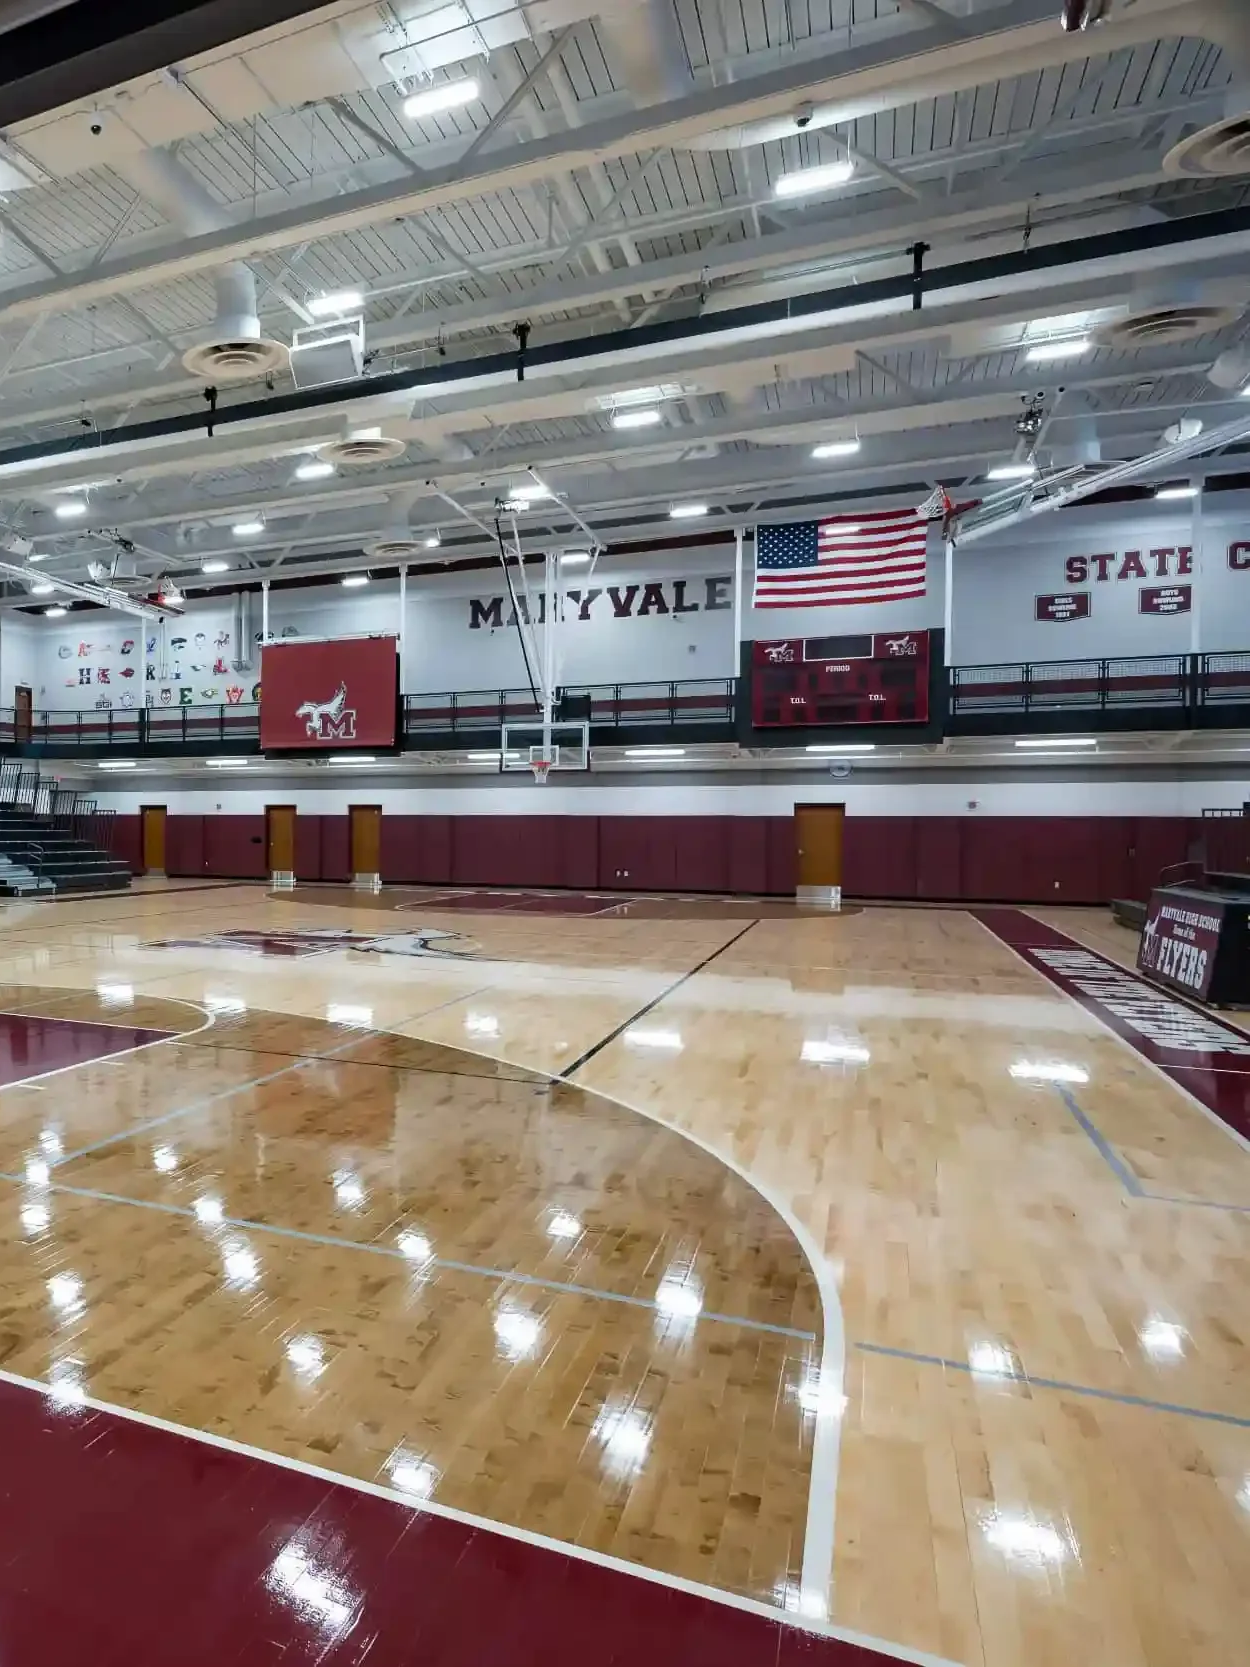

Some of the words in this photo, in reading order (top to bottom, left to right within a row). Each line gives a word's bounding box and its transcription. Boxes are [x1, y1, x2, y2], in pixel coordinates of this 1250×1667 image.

[1065, 546, 1193, 584] STATE
[825, 664, 851, 673] PERIOD
[1198, 914, 1221, 933] SCHOOL
[1156, 936, 1208, 990] FLYERS
